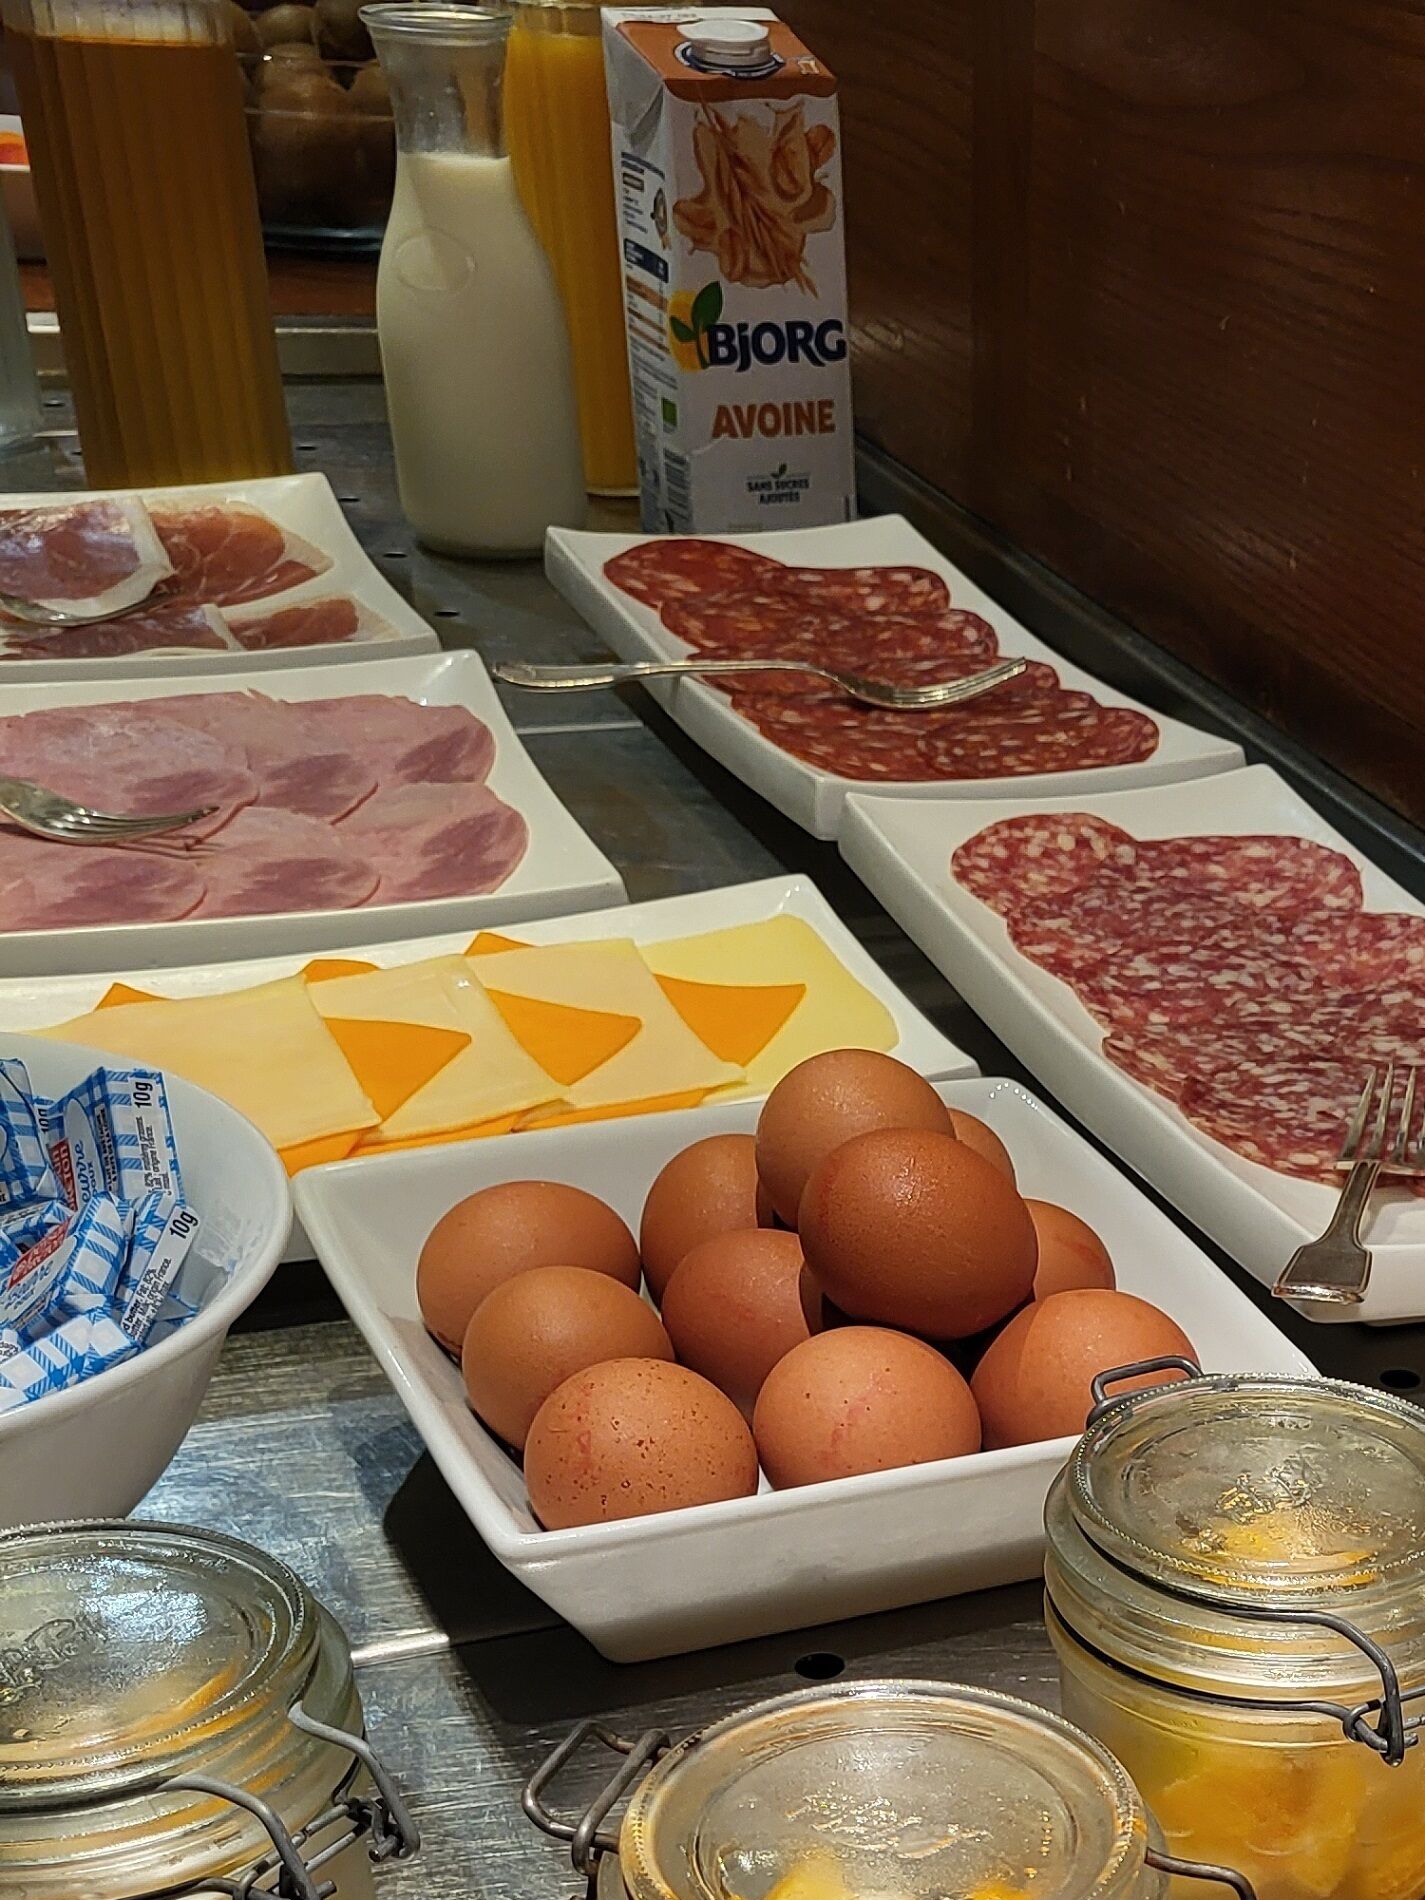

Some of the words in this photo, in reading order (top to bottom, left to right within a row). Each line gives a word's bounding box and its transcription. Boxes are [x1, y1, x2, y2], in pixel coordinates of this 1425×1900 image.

[712, 401, 836, 440] AVOINE
[133, 1081, 153, 1109] 10g
[169, 1210, 198, 1239] 10g
